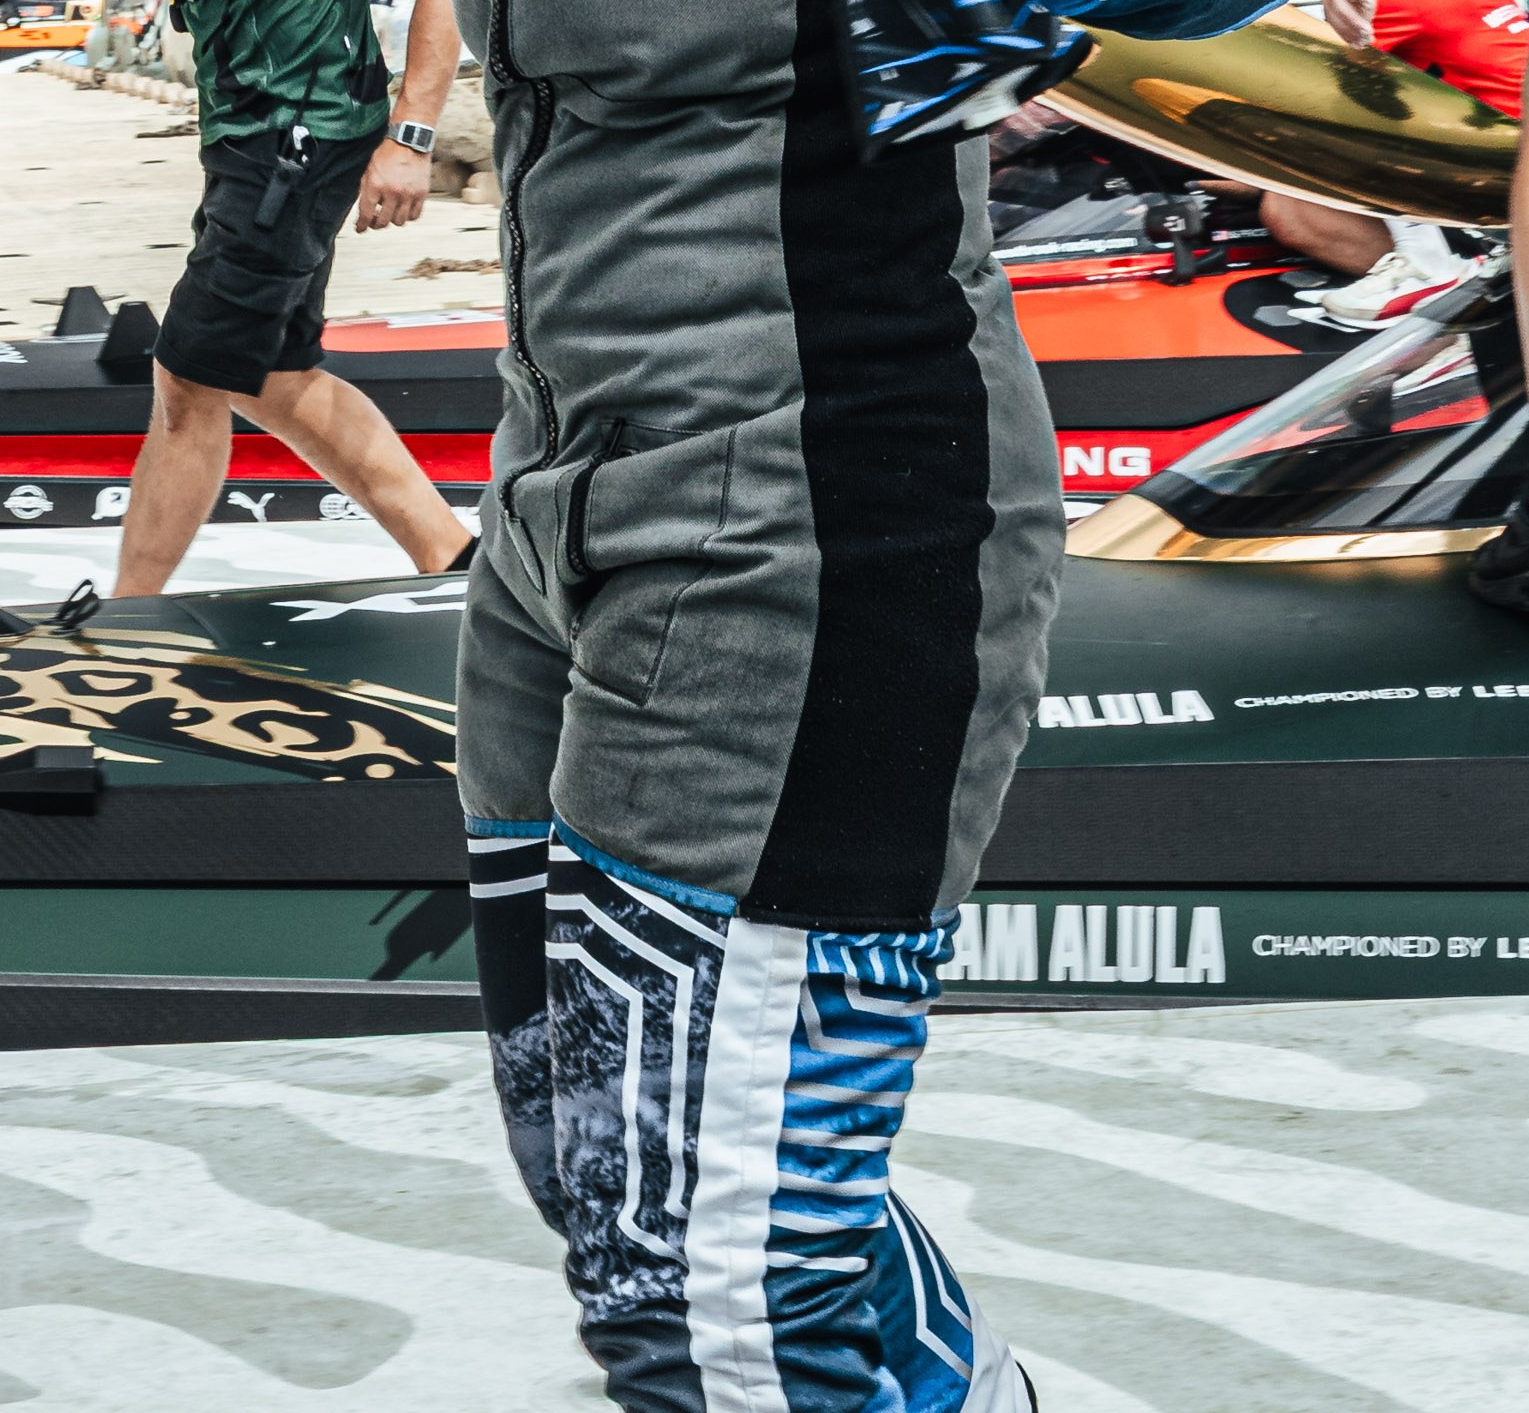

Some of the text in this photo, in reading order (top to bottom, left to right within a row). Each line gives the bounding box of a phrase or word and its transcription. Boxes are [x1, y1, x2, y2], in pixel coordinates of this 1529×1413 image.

[1063, 446, 1152, 477] NG
[1038, 690, 1215, 728] ALULA
[1234, 687, 1420, 708] CHAMPIONED
[1425, 686, 1463, 698] BY
[1048, 904, 1227, 983] ALULA
[1252, 934, 1441, 957] CHAMPIONED
[1447, 937, 1488, 957] BY
